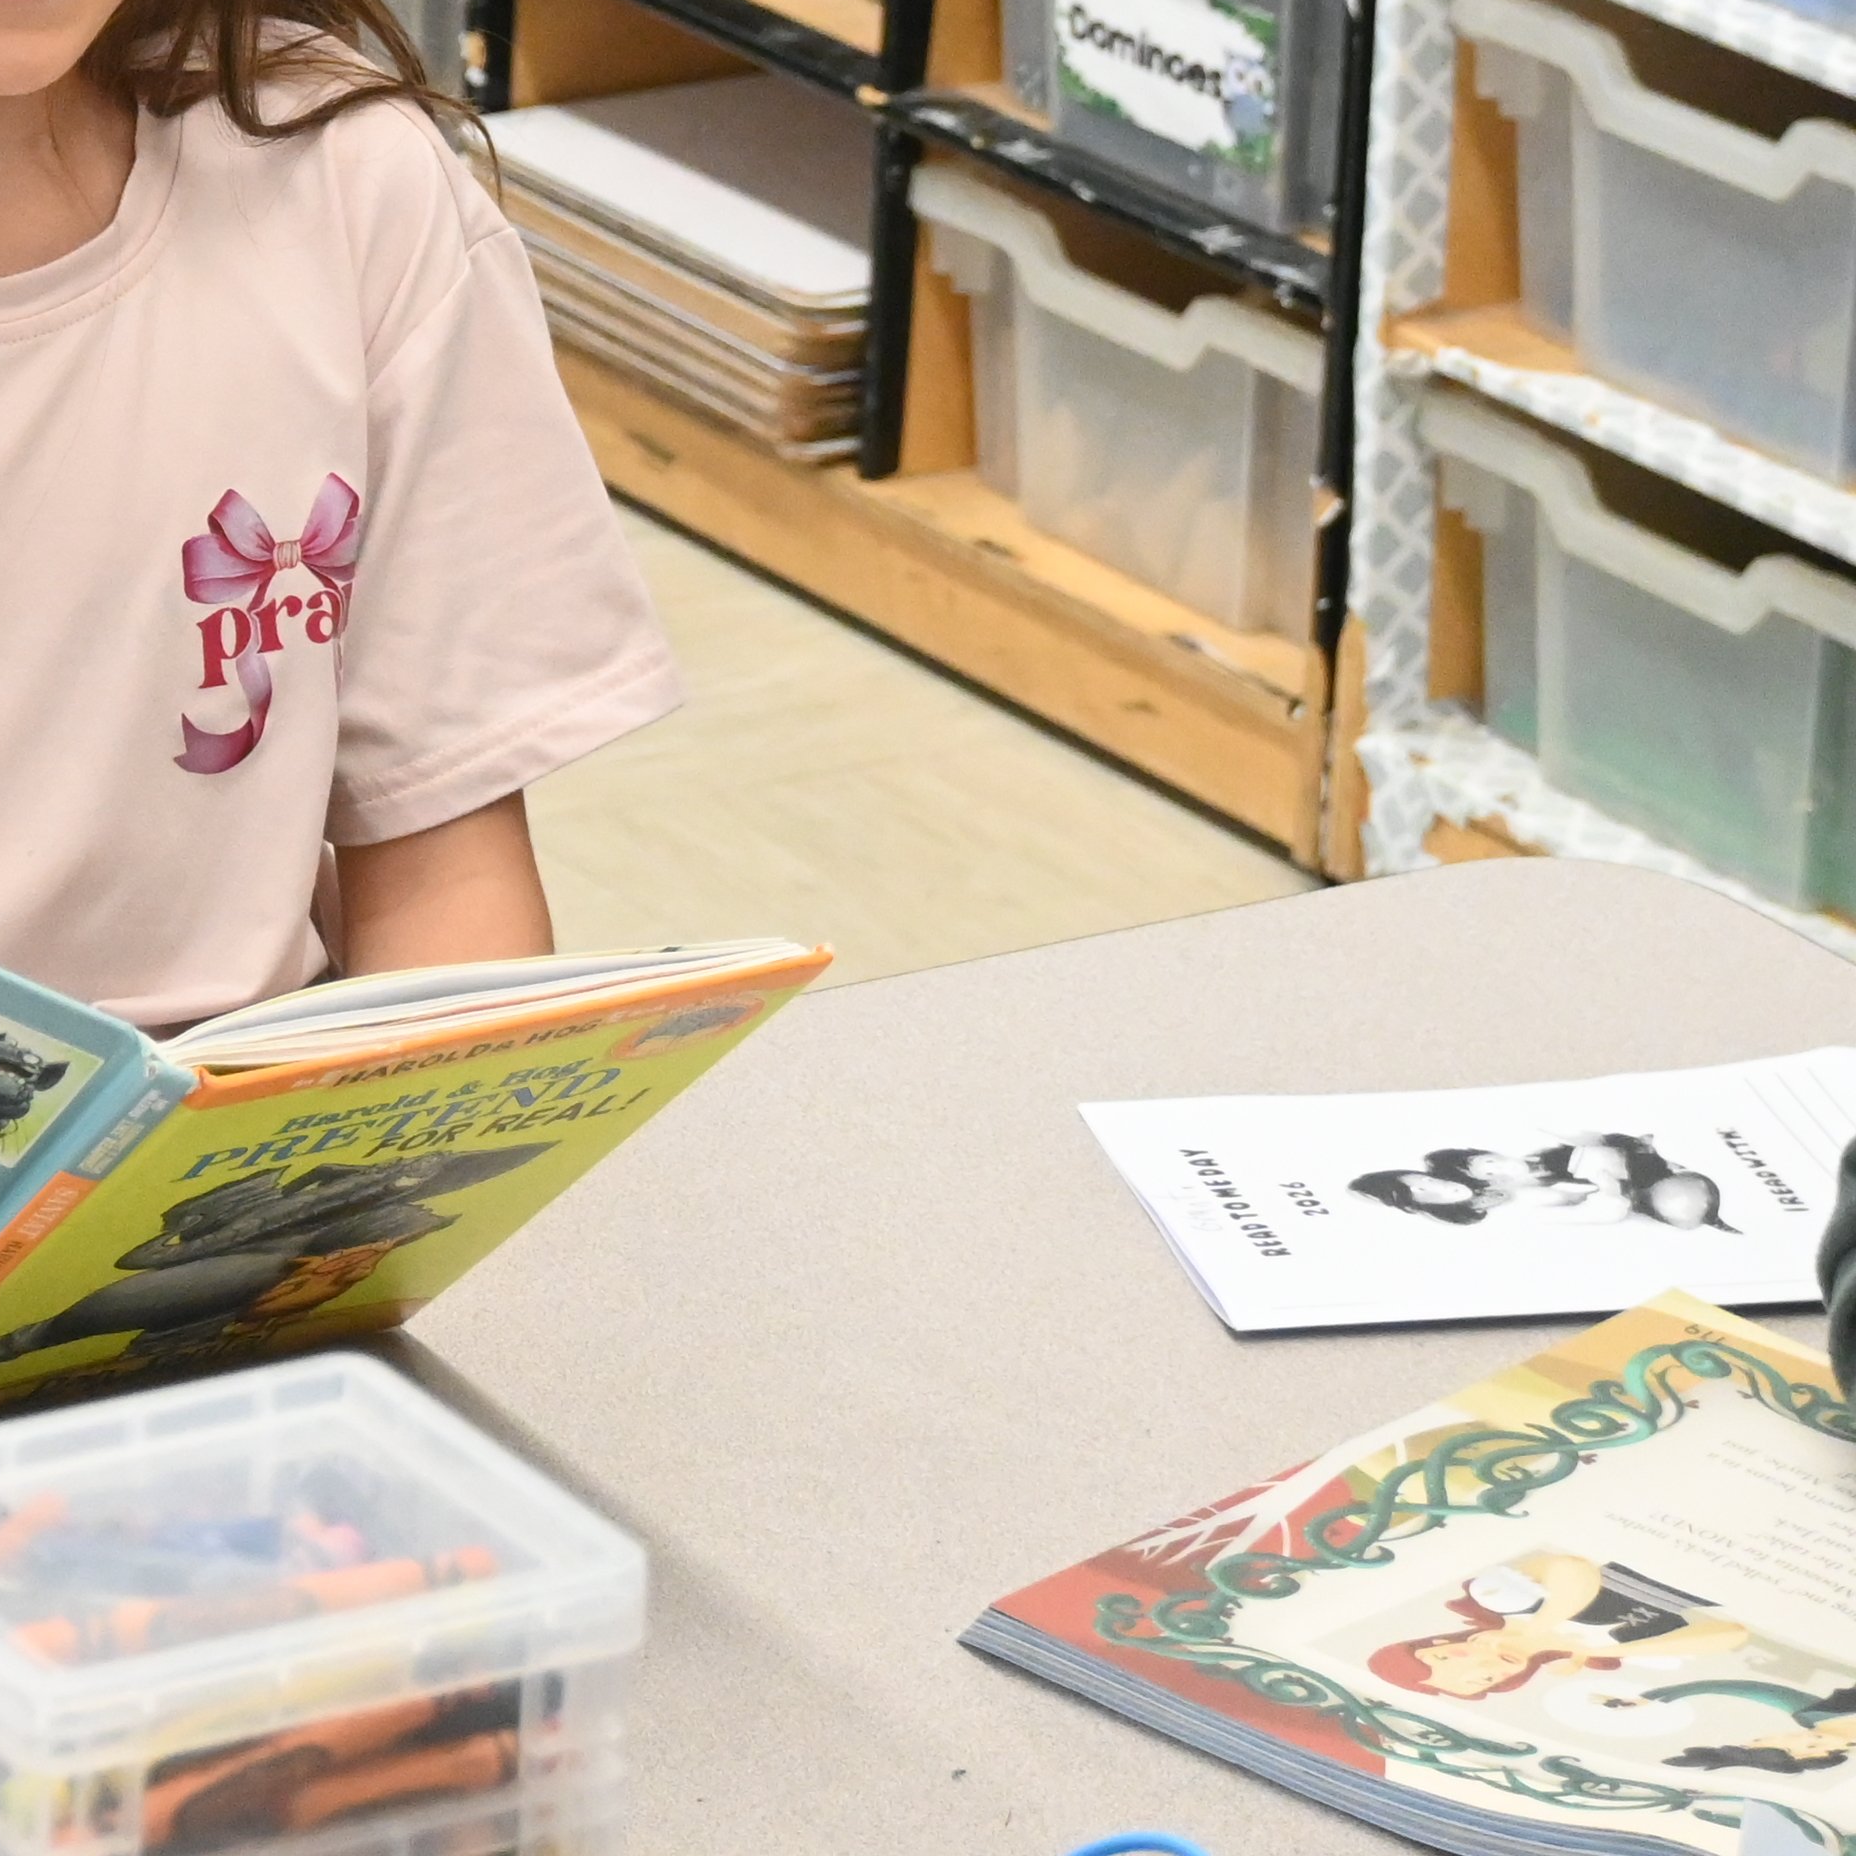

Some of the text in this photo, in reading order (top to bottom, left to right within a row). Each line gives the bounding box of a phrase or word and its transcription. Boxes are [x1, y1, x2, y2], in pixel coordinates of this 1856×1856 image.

[1066, 2, 1224, 100] Dominoes
[196, 582, 353, 689] pra
[334, 1040, 496, 1087] HAROLD
[528, 1019, 602, 1044] HOG
[170, 1066, 622, 1182] PRETEND
[272, 1057, 593, 1136] Harold & Hog
[361, 1088, 651, 1158] FOR REAL!
[1178, 1149, 1225, 1177] DAY
[1202, 1180, 1242, 1198] ME
[1755, 1171, 1805, 1206] READ
[16, 1180, 78, 1244] SANTAT
[1223, 1201, 1258, 1220] TO
[1278, 1181, 1330, 1217] 2026
[1241, 1223, 1291, 1257] READ
